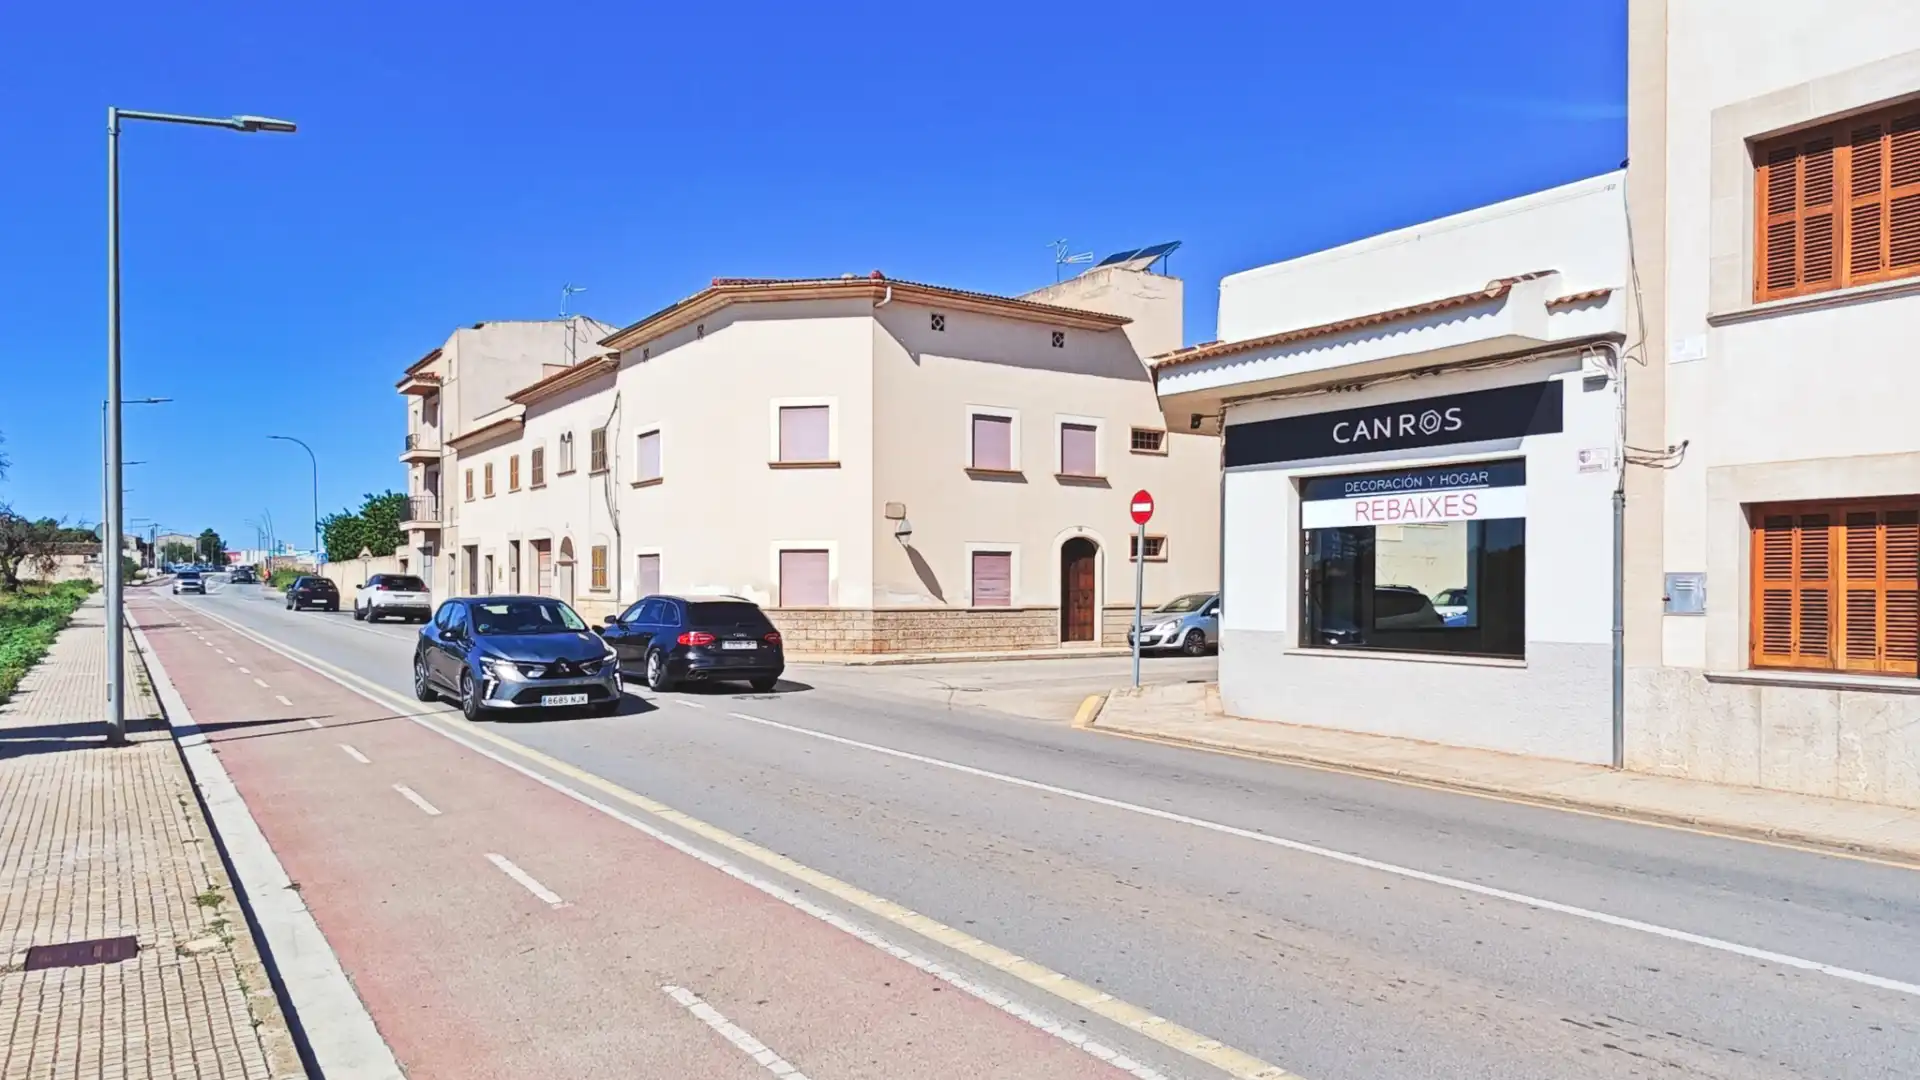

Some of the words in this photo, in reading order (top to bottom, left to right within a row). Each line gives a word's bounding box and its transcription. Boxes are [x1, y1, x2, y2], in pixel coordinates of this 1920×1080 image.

[1345, 473, 1422, 492] DECORACIÓN
[1427, 476, 1435, 486] Y
[1440, 471, 1488, 485] HOGAR
[1355, 493, 1478, 522] REBAIXES
